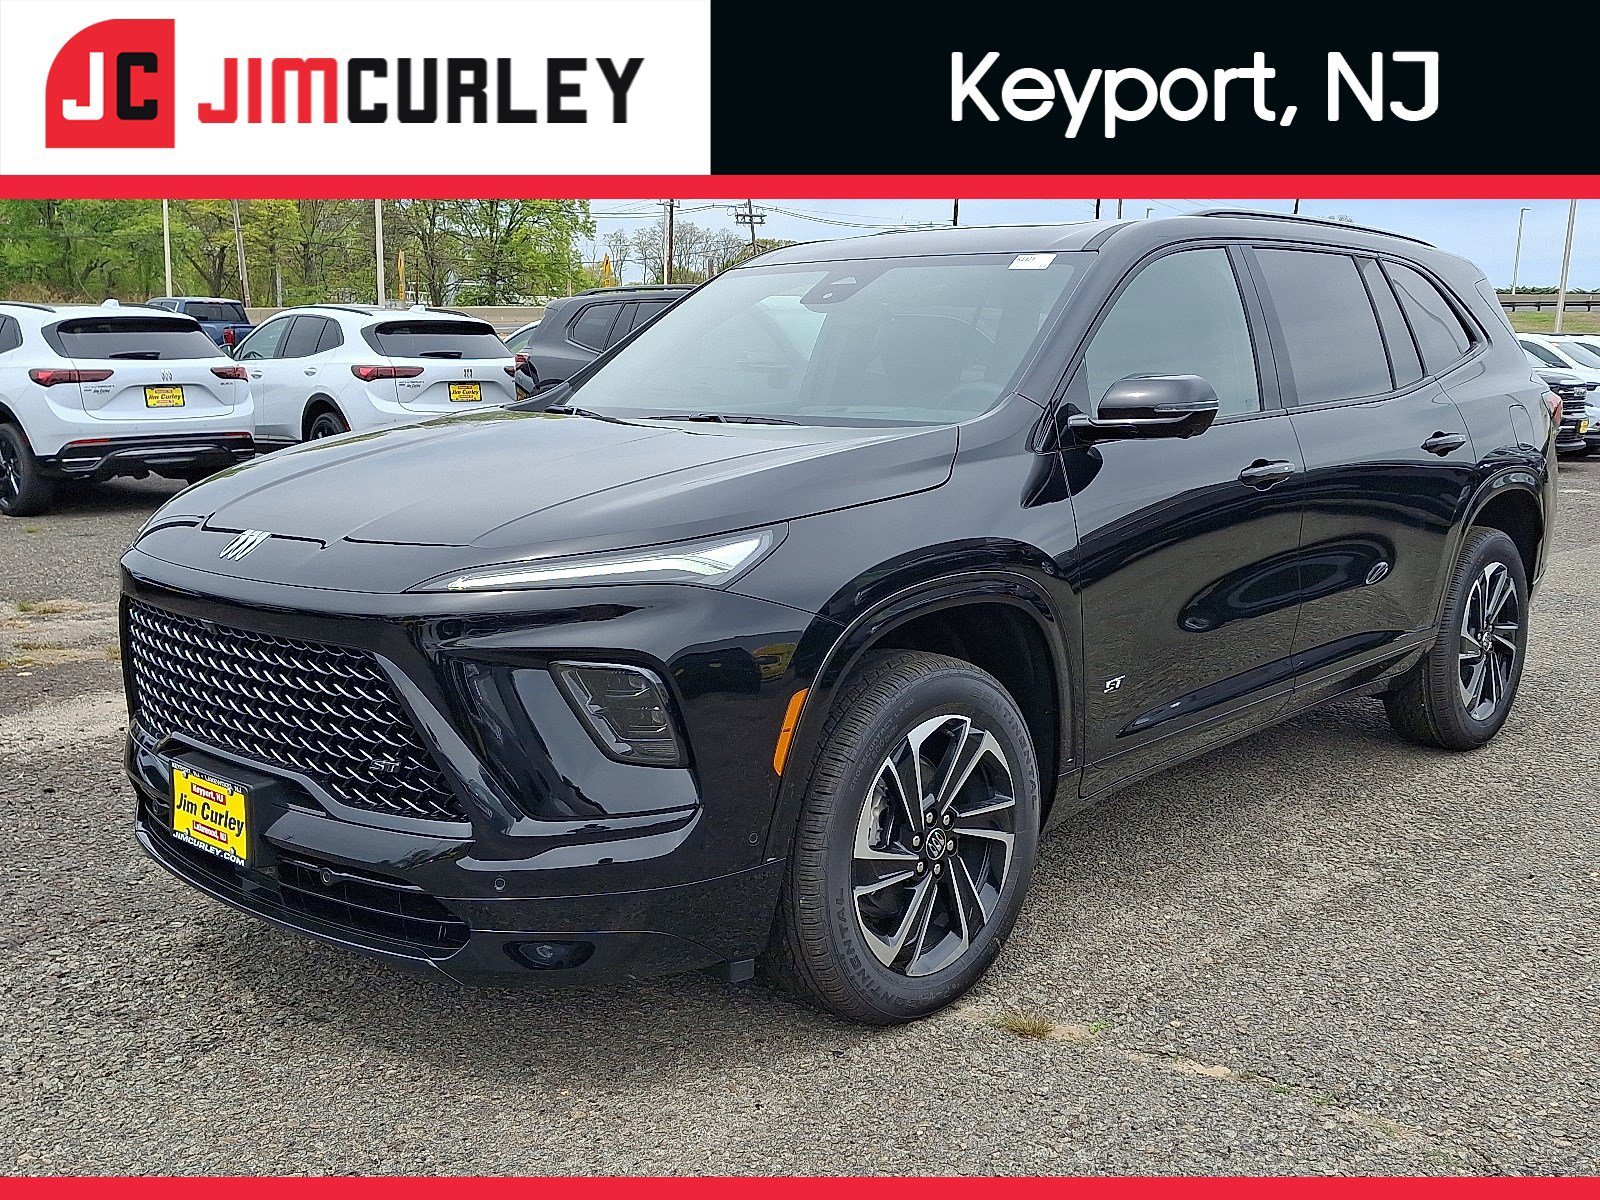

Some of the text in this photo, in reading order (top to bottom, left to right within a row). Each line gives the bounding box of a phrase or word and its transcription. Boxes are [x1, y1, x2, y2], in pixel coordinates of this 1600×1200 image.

[369, 759, 401, 773] ST
[176, 792, 244, 838] Jim Curley
[172, 831, 245, 867] JIMCURLEY.COM
